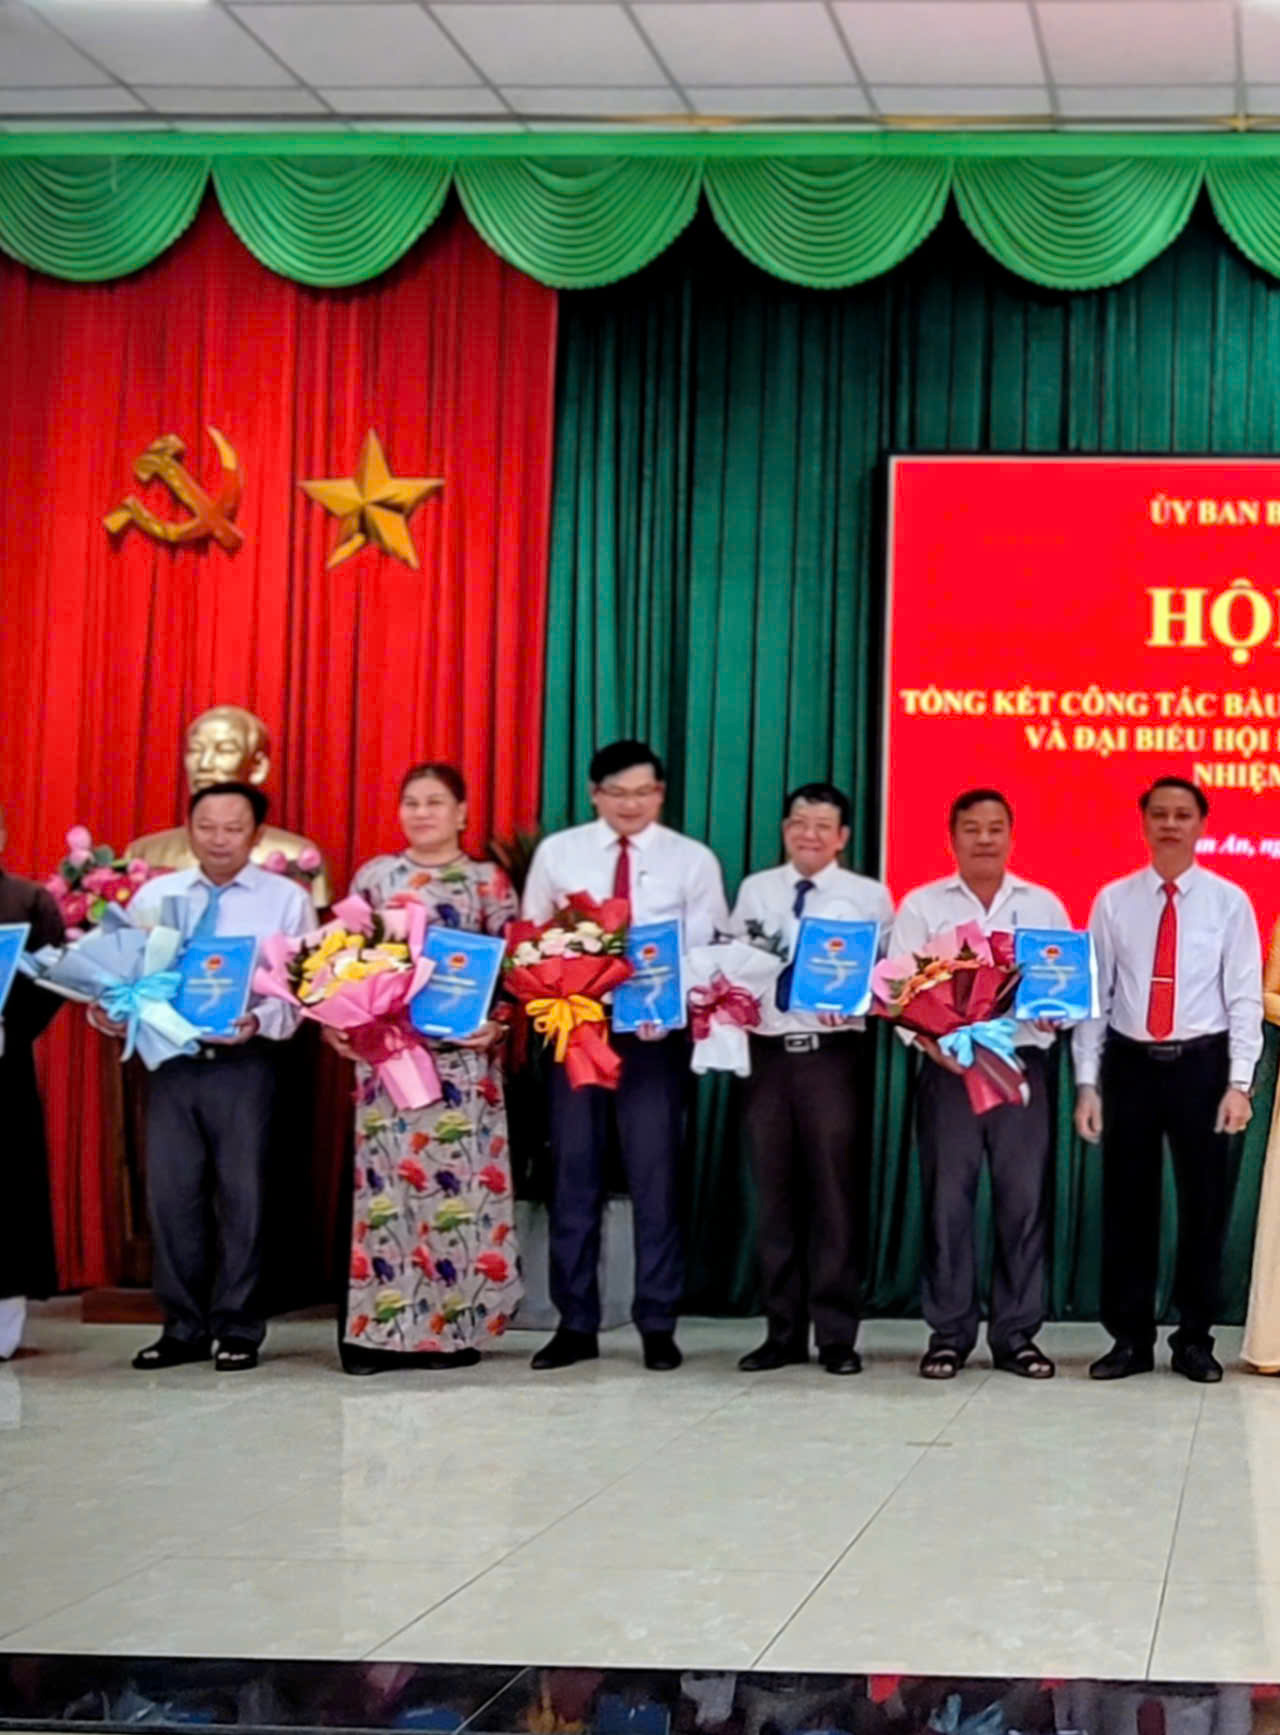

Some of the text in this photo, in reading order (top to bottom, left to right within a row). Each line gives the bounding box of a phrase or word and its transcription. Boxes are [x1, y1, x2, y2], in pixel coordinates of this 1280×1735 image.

[1199, 499, 1259, 526] BAN
[1060, 685, 1149, 717] CÔNG
[1154, 687, 1217, 718] TÁC
[1025, 719, 1066, 751] VÀ
[1074, 725, 1127, 757] ĐẠI
[1213, 725, 1270, 758] HỘI
